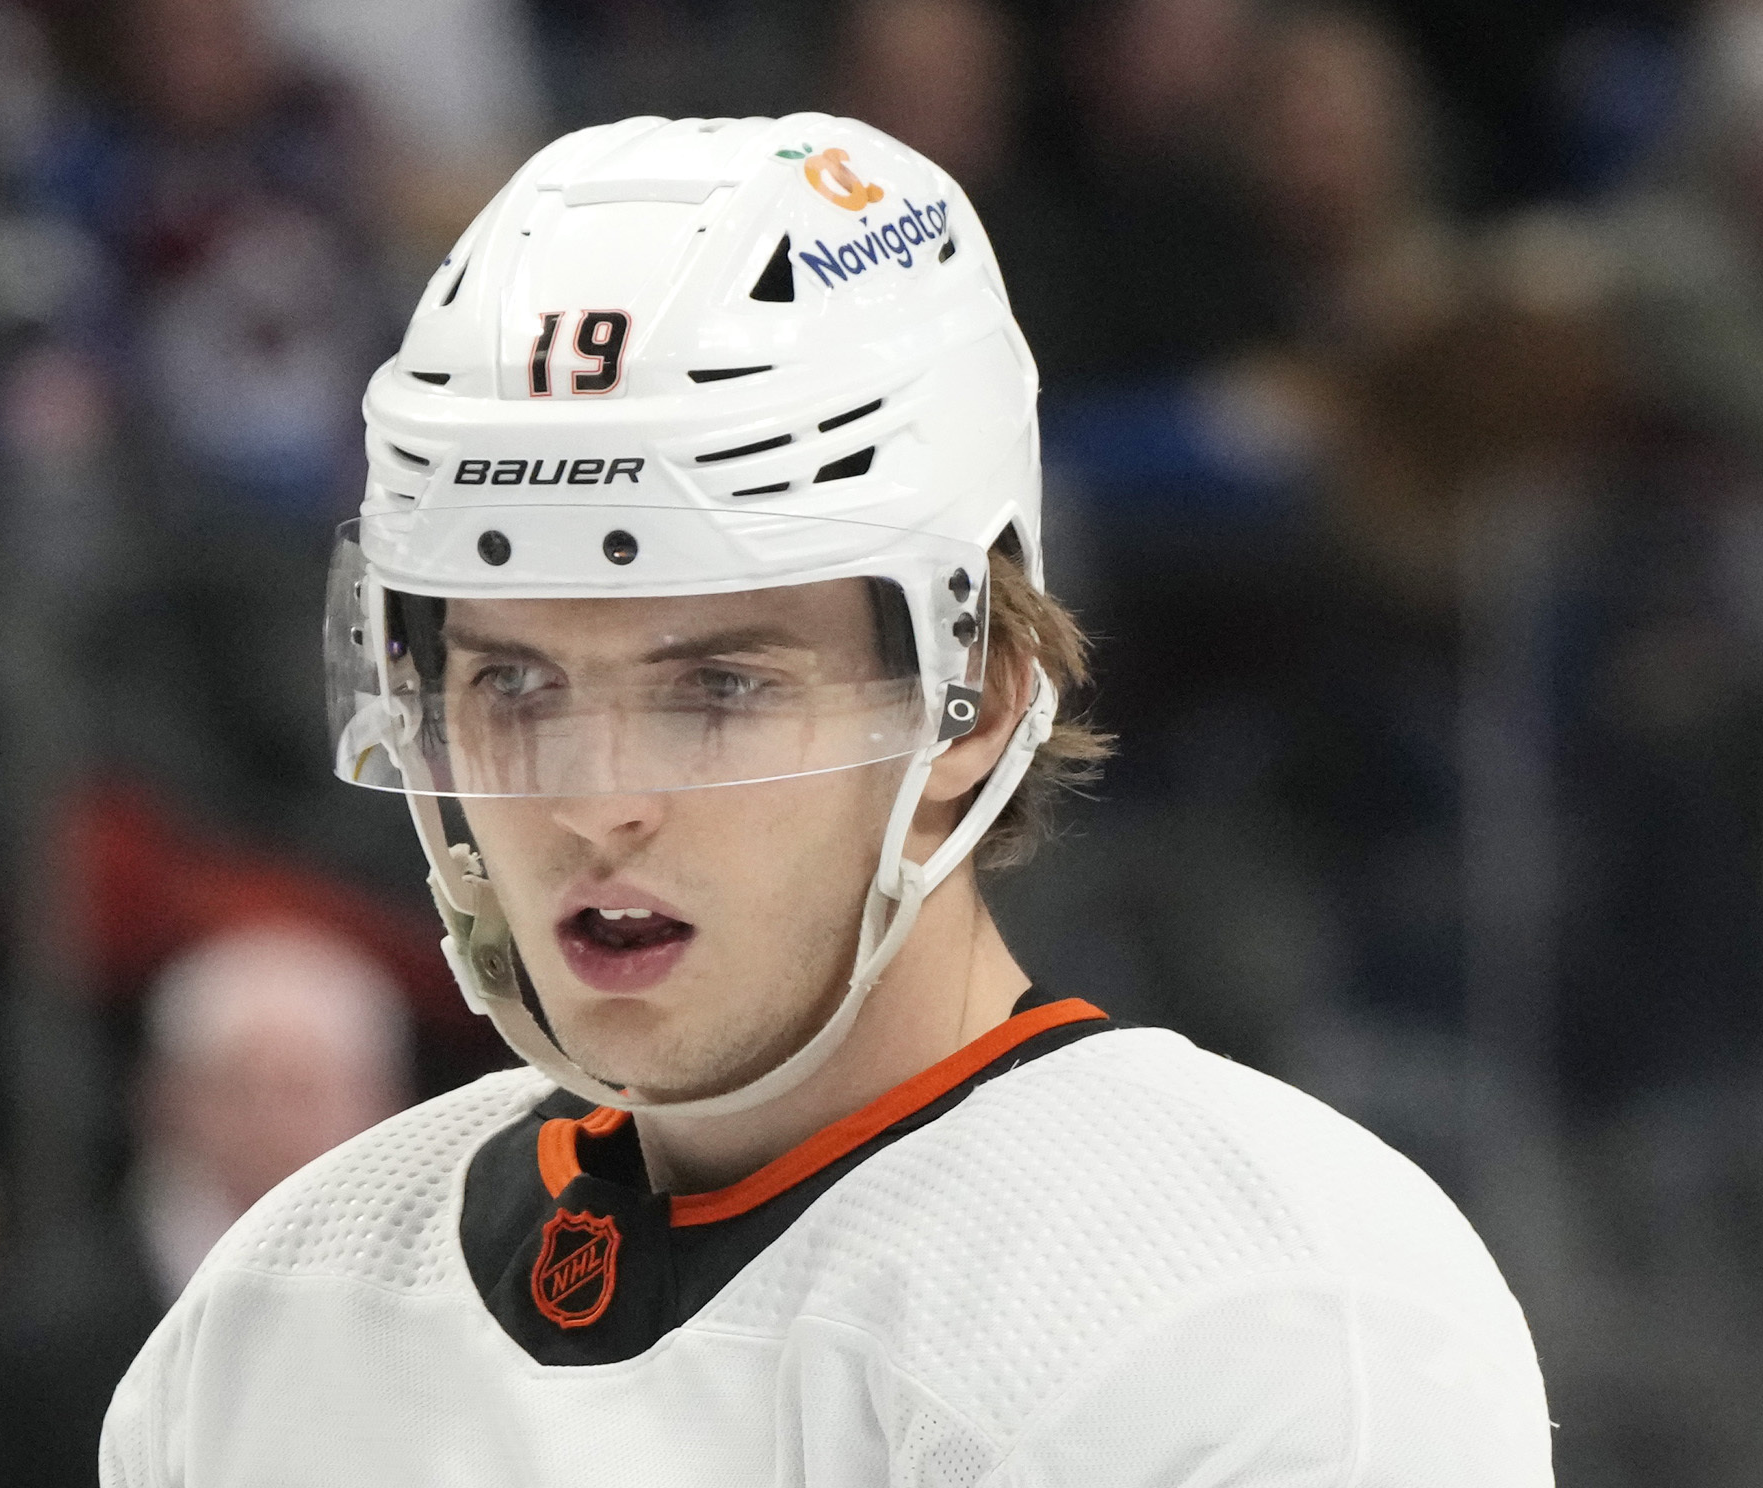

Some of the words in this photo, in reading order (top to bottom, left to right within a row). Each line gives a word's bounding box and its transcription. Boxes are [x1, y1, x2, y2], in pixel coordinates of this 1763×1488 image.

[799, 198, 947, 289] Navigator
[528, 308, 632, 398] 19
[453, 457, 645, 486] BAUER
[551, 1245, 603, 1298] NHL
